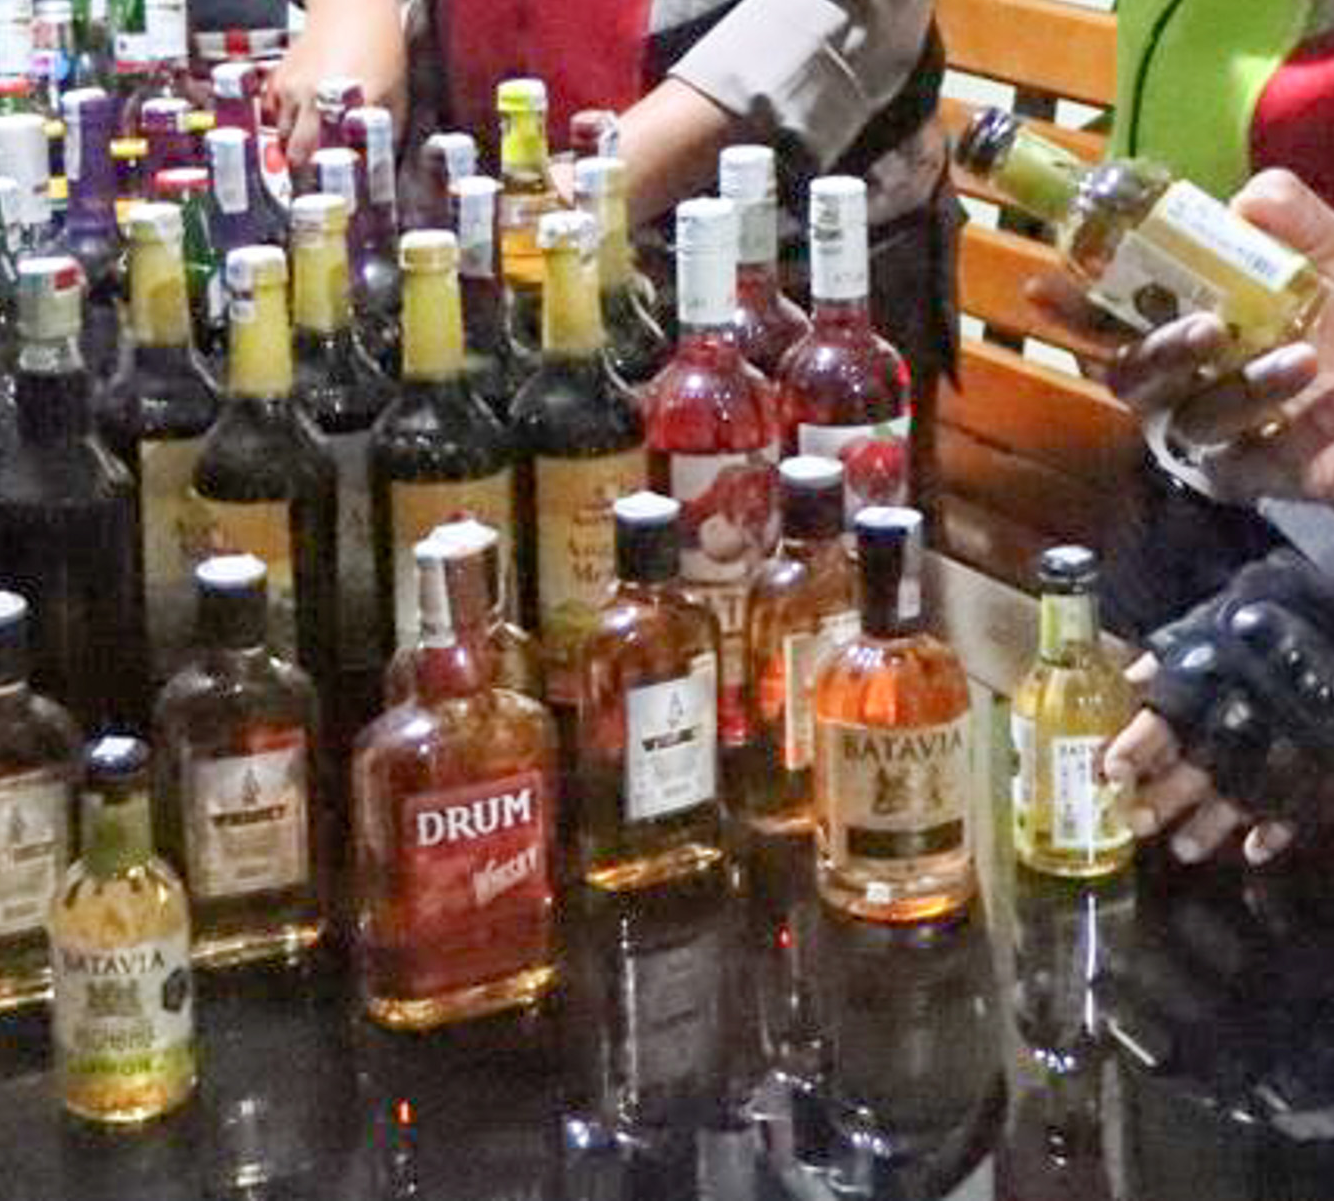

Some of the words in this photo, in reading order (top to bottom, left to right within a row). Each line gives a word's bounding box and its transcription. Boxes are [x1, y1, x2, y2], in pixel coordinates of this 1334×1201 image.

[842, 727, 964, 763] BATAVIA
[416, 788, 532, 847] DRUM
[61, 949, 167, 978] BATAVIA
